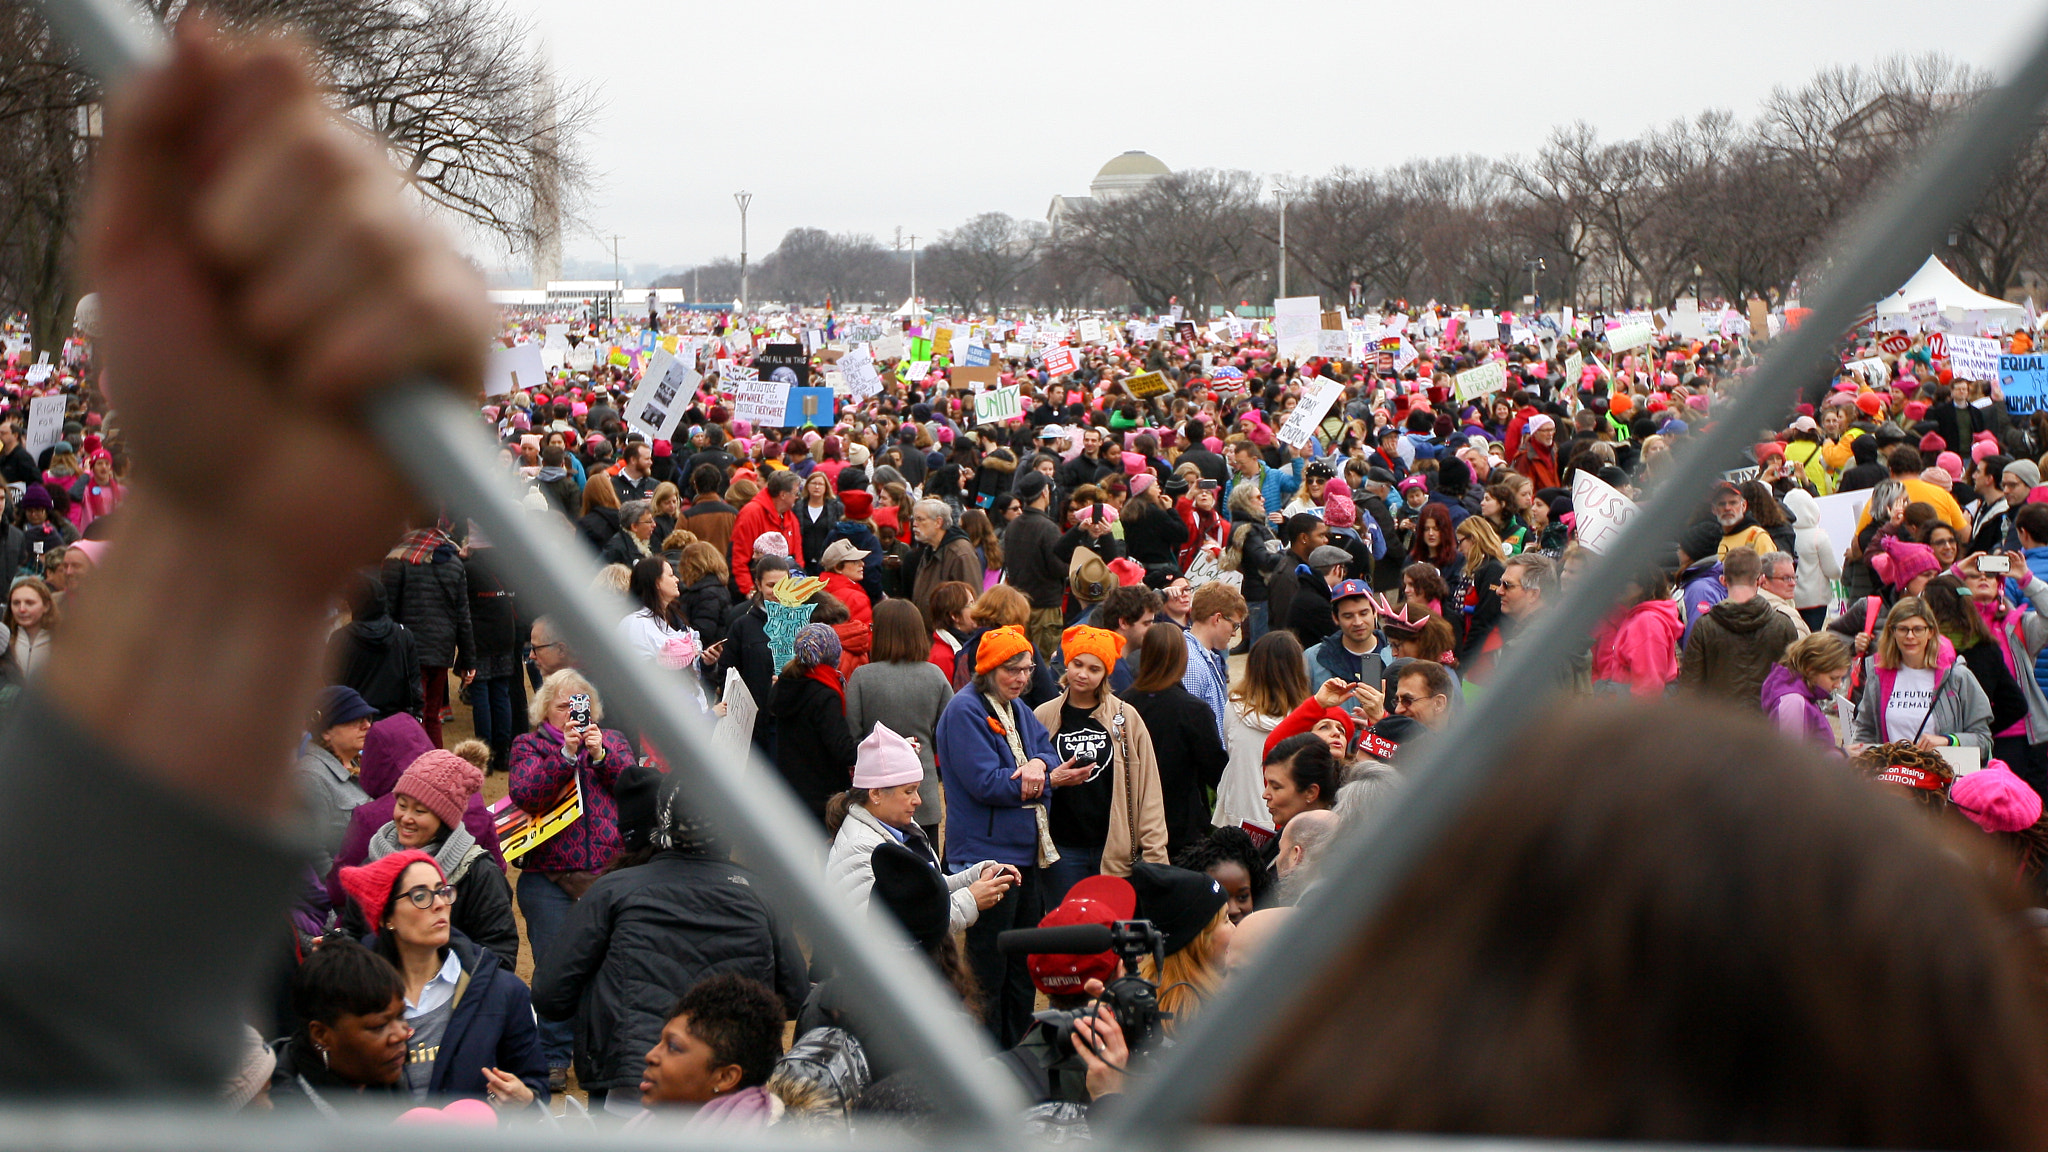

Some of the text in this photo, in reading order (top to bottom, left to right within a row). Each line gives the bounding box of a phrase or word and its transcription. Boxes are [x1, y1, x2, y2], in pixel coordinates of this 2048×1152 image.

[1885, 339, 1908, 352] NO
[772, 355, 783, 364] ALL
[785, 356, 792, 364] IN
[793, 356, 807, 364] THIS
[2001, 356, 2045, 371] EQUAL
[1462, 363, 1499, 383] RESIST
[1466, 376, 1501, 395] TRUMP
[737, 393, 764, 404] ANYWHERE
[975, 385, 1019, 419] UNITY
[1299, 396, 1319, 416] TODAY
[2005, 395, 2037, 412] HUMAN
[36, 401, 64, 416] RIGHTS
[754, 405, 784, 417] EVERYWHERE
[33, 432, 48, 447] ALL
[1573, 478, 1636, 525] PUSS
[767, 603, 812, 620] MIGHTY
[1890, 691, 1933, 699] HE FUTUR
[1064, 734, 1107, 742] RAIDERS
[1375, 737, 1391, 749] One
[1877, 774, 1917, 786] OLUTION
[1901, 766, 1925, 780] Rising
